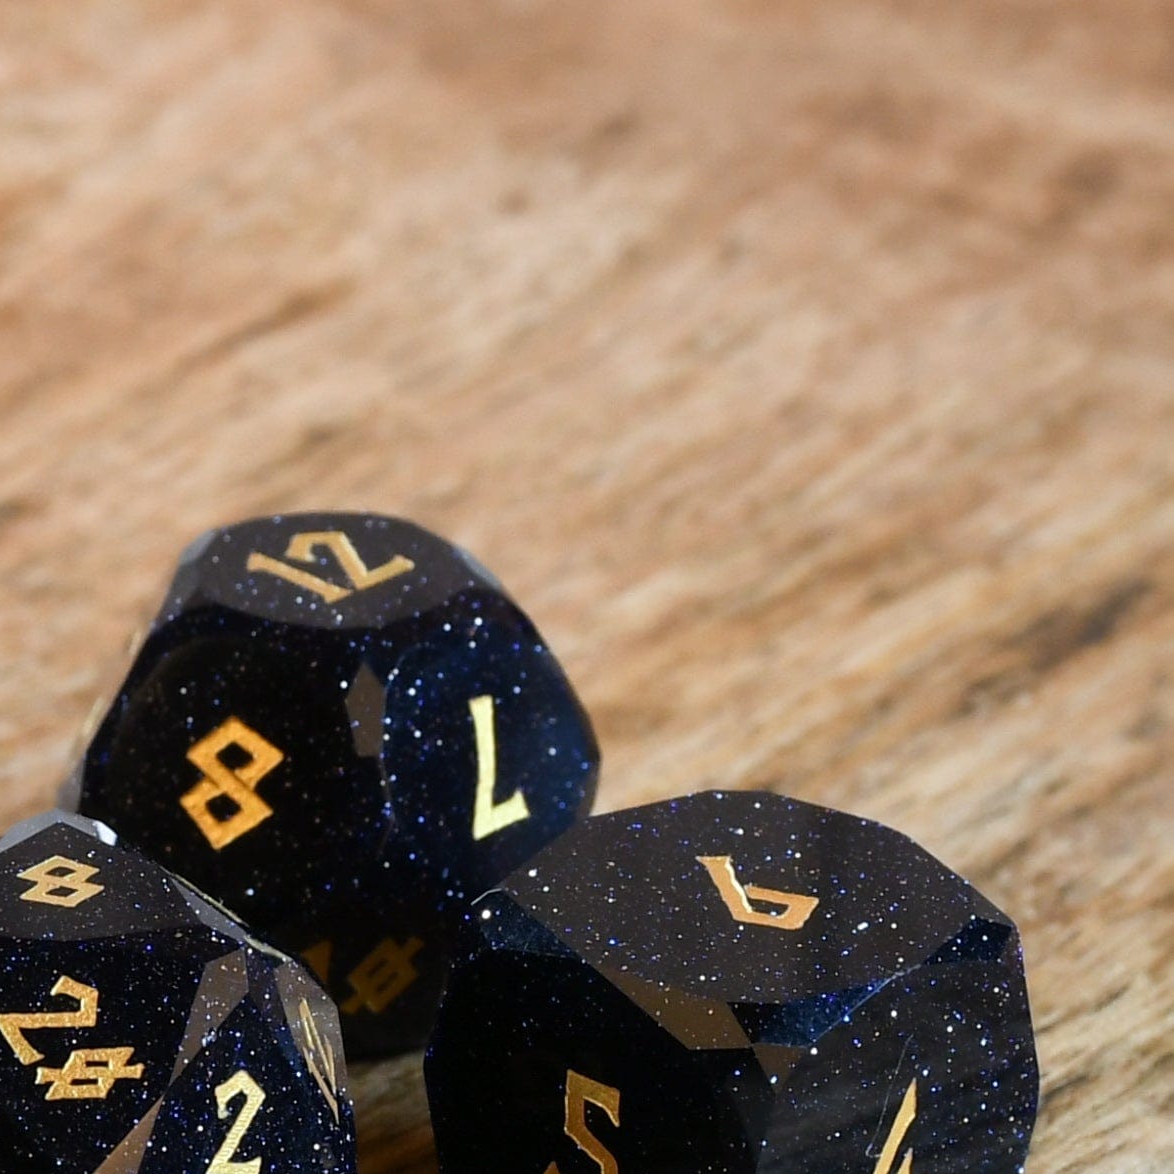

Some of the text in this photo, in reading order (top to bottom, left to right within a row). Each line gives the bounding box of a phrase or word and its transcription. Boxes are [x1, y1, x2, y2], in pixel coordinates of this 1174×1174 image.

[247, 530, 416, 604] 12
[179, 715, 285, 852] 8
[17, 854, 104, 908] 8
